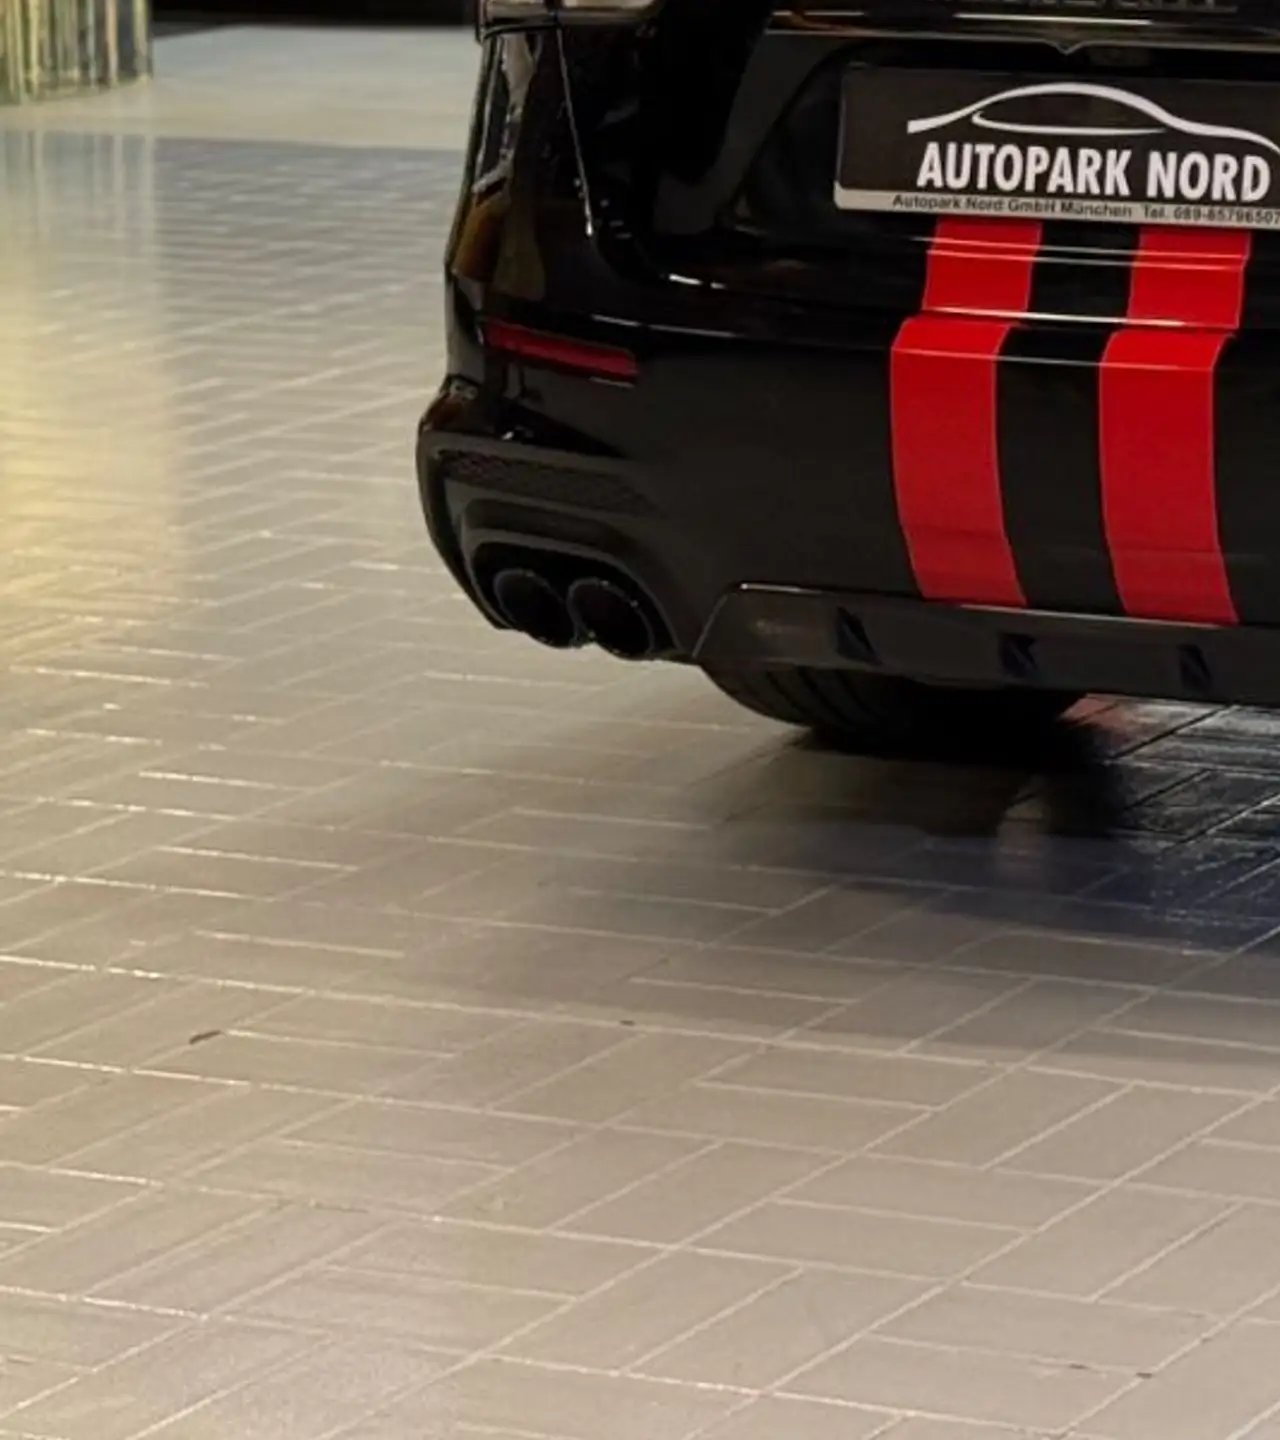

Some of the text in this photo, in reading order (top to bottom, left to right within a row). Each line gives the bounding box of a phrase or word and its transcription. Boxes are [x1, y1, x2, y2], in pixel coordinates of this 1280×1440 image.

[916, 141, 1271, 202] AUTOPARK NORD
[892, 194, 961, 210] Autopark
[965, 197, 1005, 211] Nord
[1008, 199, 1055, 213] GmbH
[1060, 200, 1132, 218] München
[1142, 204, 1168, 219] Tel.
